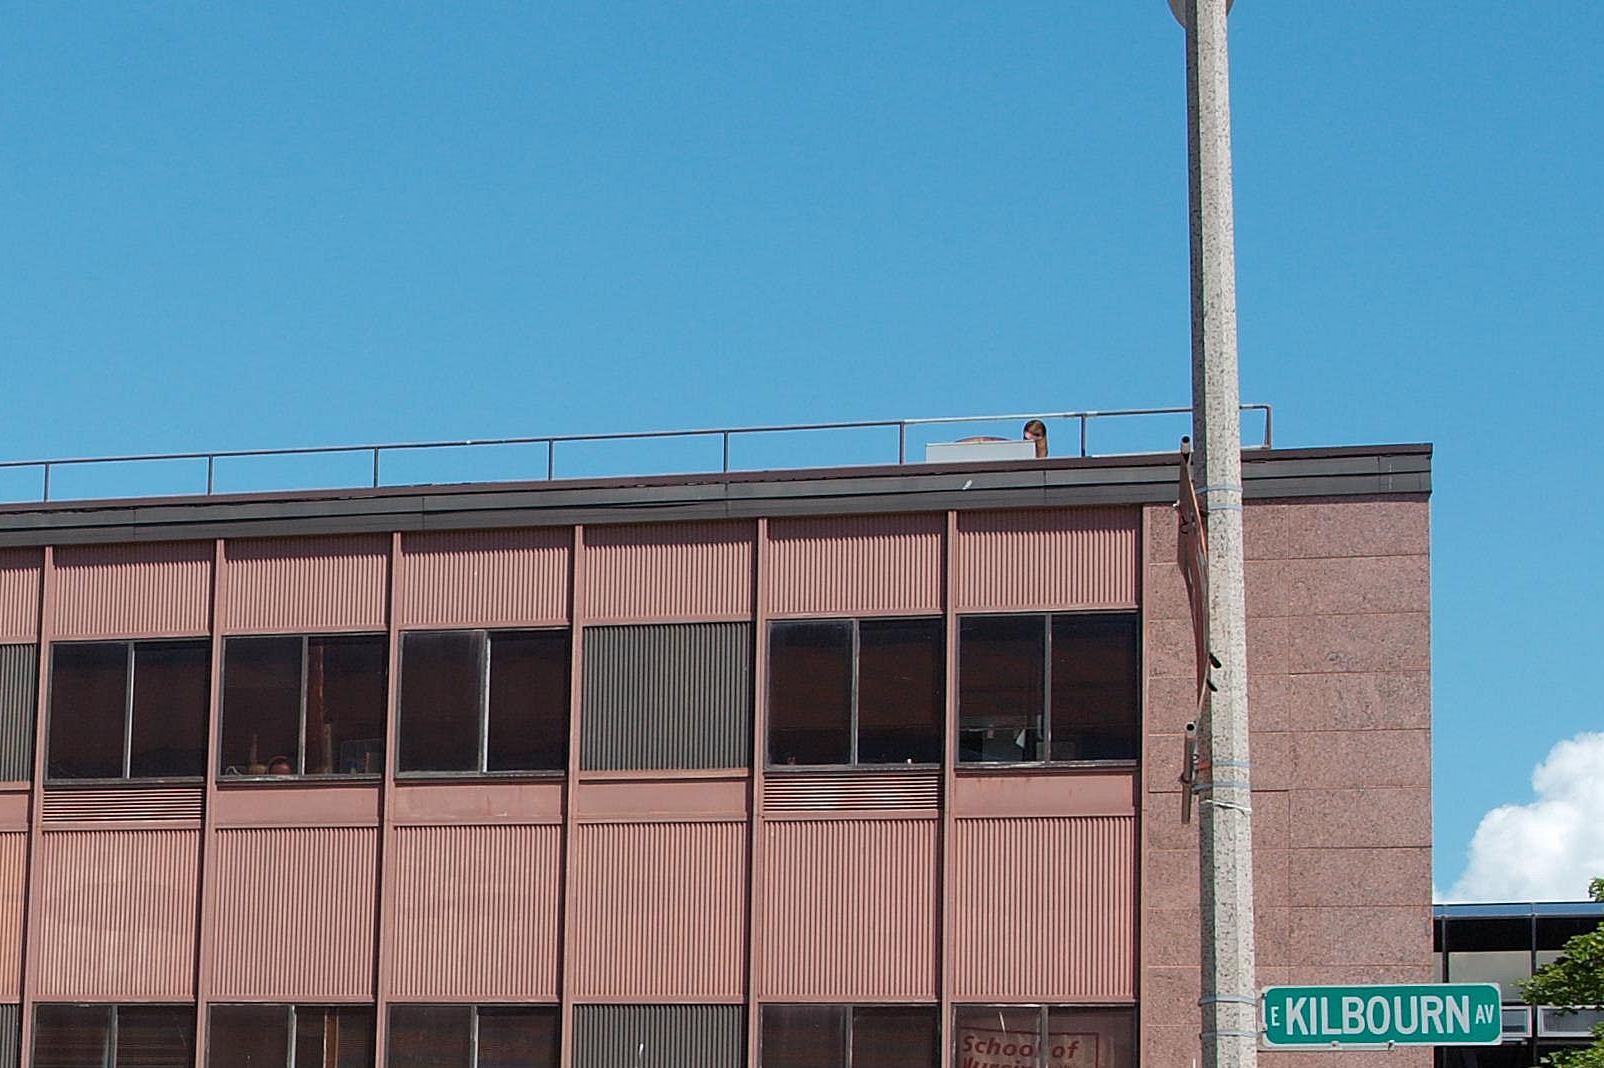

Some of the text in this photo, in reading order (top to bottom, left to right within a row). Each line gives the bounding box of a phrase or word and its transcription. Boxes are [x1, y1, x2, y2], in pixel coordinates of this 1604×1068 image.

[1271, 995, 1494, 1036] E KILBOURN AV
[963, 1035, 1080, 1059] Schoo of
